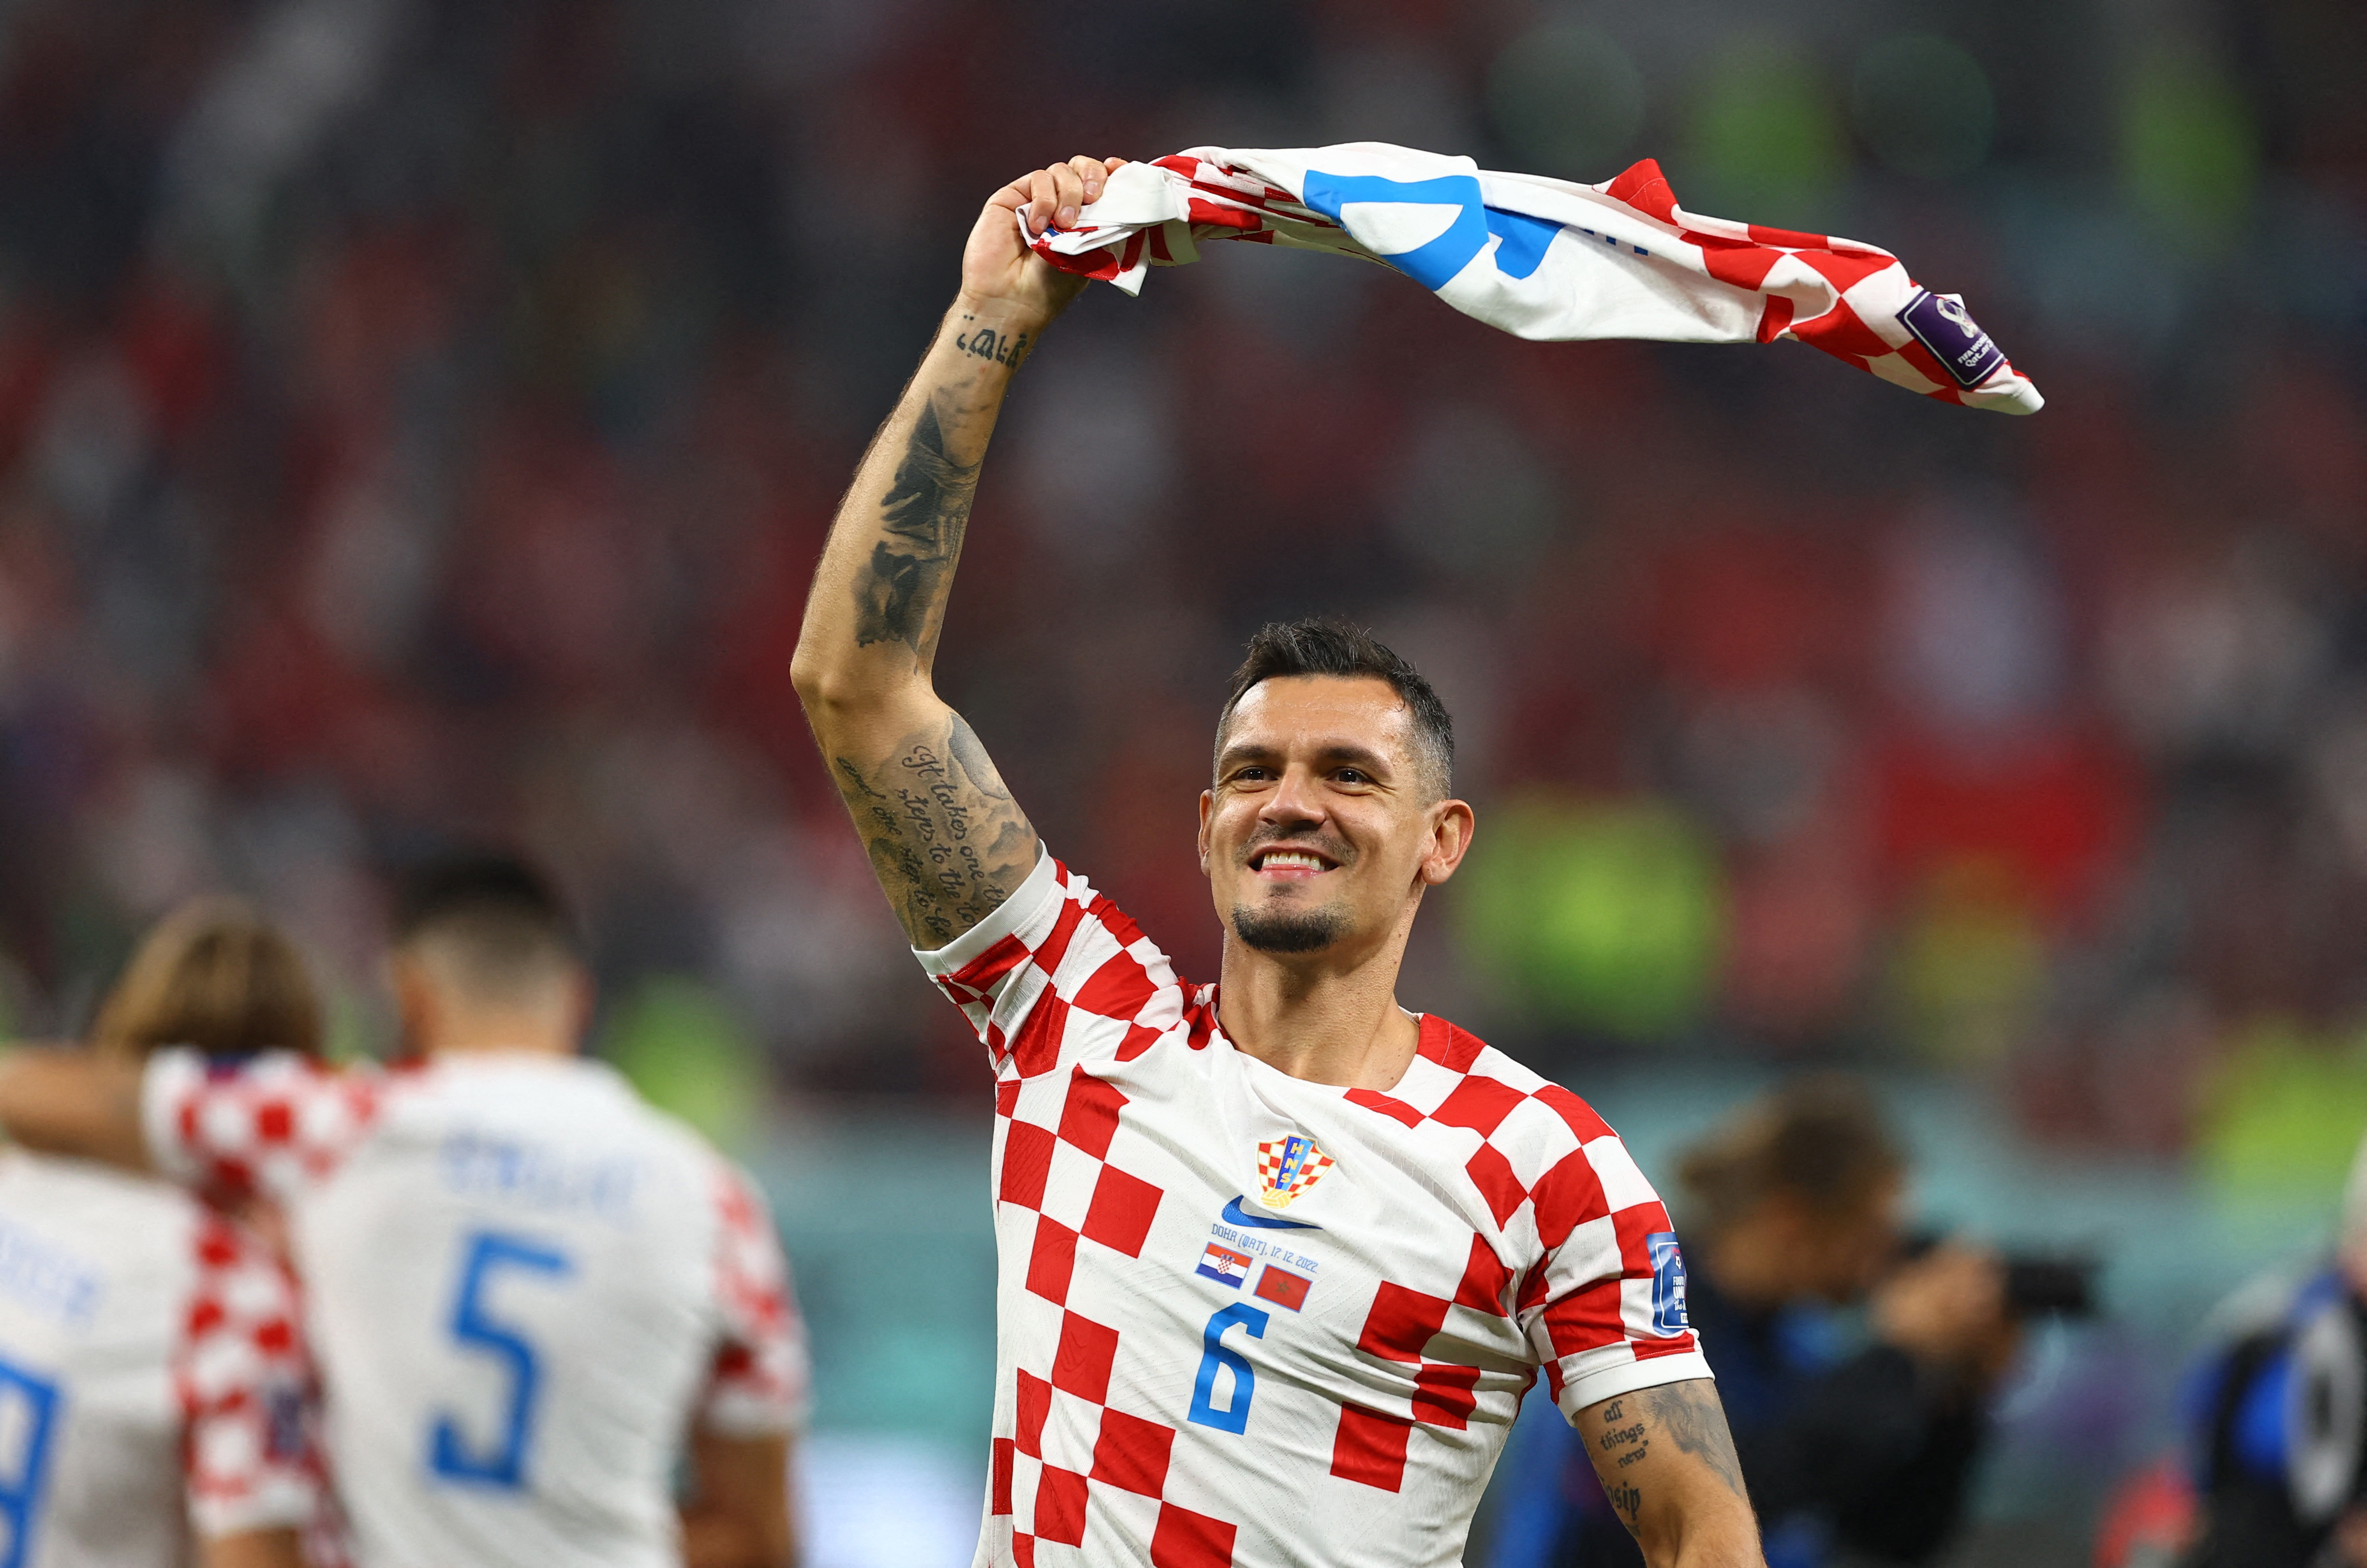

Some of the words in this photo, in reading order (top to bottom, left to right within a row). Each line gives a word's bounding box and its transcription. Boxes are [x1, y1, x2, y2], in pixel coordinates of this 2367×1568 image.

[1957, 350, 1974, 364] FIFA
[894, 789, 936, 842] steps
[930, 780, 968, 840] takes
[959, 845, 985, 880] one
[872, 806, 902, 836] one
[898, 844, 924, 884] step
[913, 887, 936, 910] to
[929, 842, 952, 864] to
[939, 868, 966, 899] the
[1279, 1142, 1305, 1184] HNS
[1211, 1223, 1238, 1242] DOHA
[427, 1228, 575, 1491] 5
[1187, 1302, 1270, 1436] 6
[1600, 1422, 1645, 1451] things
